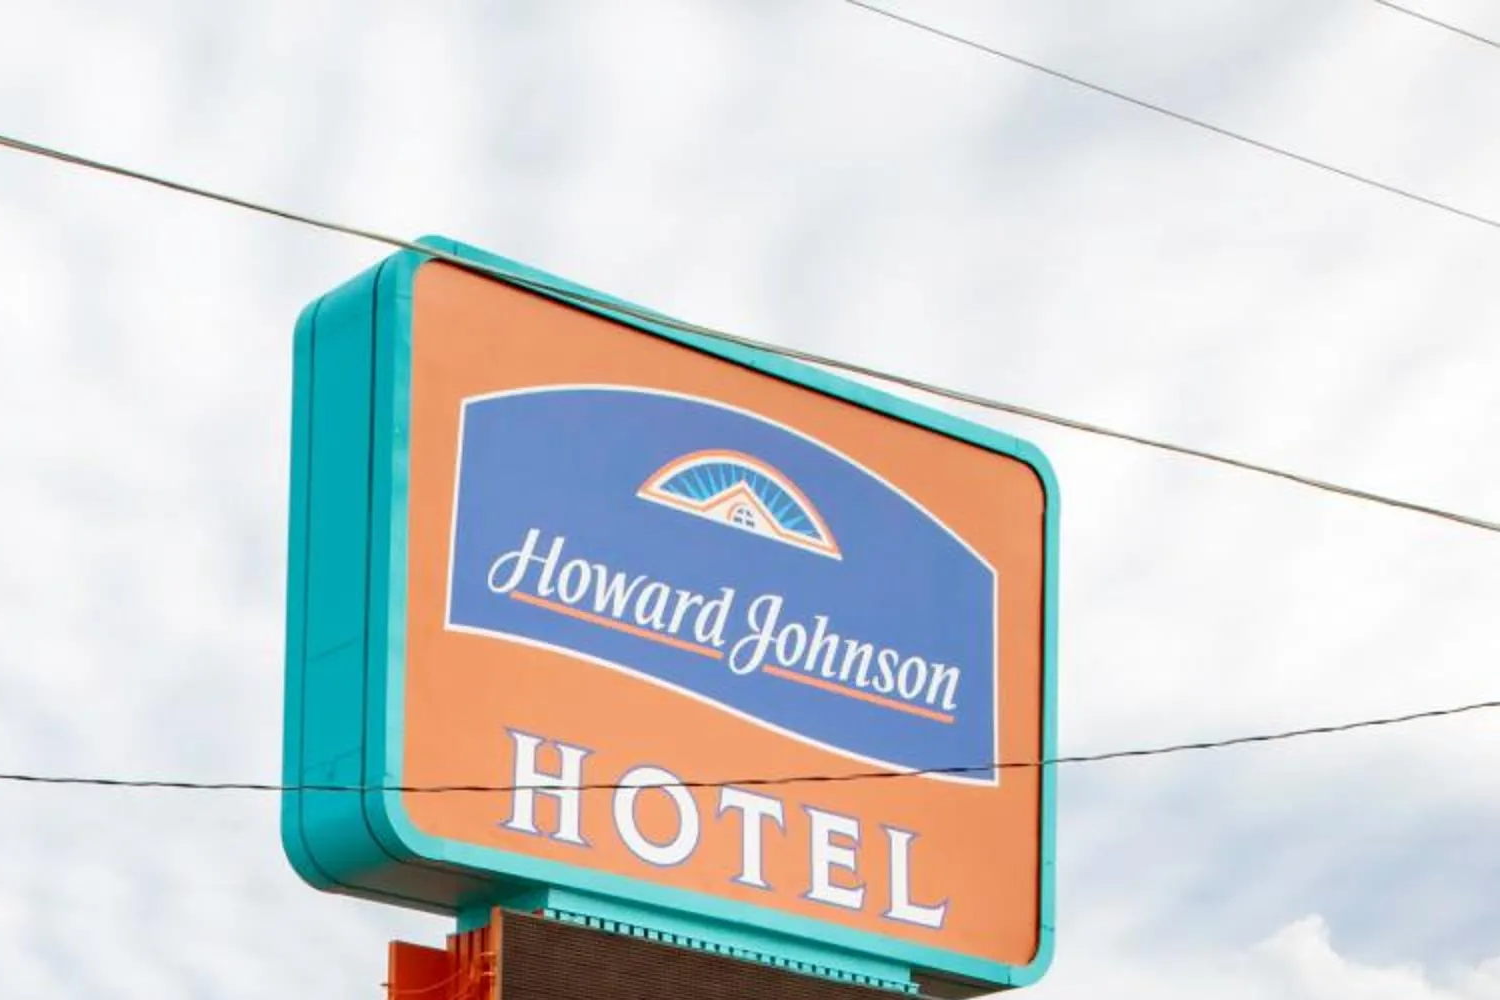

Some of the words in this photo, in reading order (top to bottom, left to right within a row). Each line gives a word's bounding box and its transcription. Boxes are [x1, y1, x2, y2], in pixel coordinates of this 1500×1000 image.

[487, 527, 736, 647] Howard
[728, 594, 961, 711] Johnson
[501, 729, 947, 929] HOTEL
